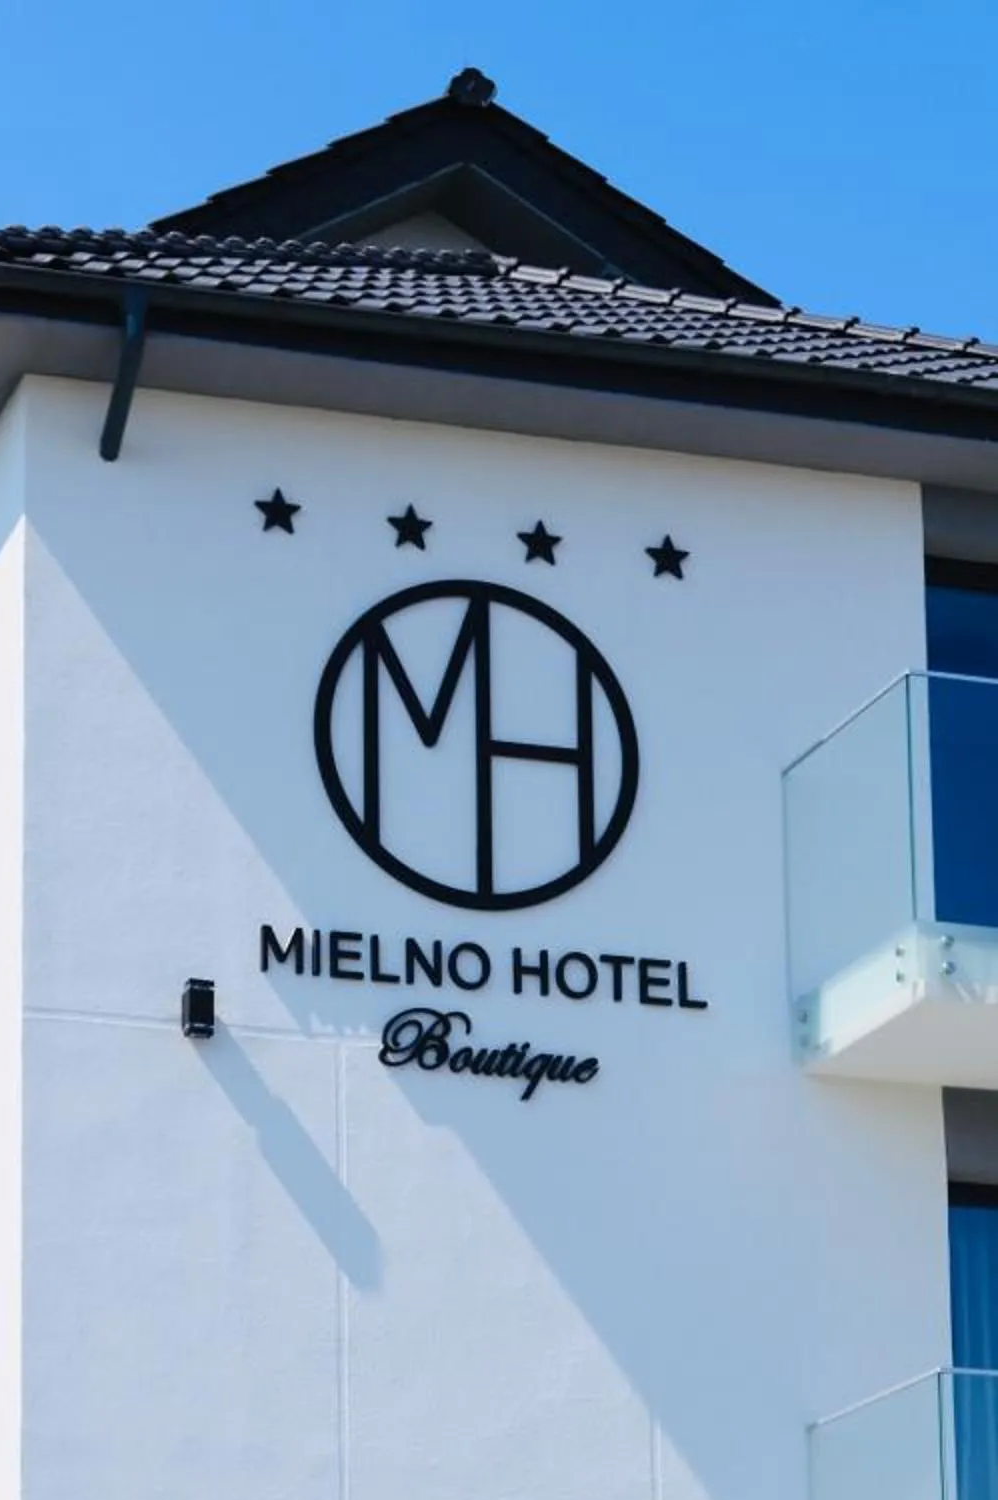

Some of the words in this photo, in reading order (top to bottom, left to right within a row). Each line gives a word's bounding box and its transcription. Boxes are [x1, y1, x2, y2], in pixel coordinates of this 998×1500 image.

[347, 584, 606, 906] MH
[259, 924, 492, 991] MIELNO
[511, 946, 709, 1010] HOTEL
[377, 1006, 600, 1102] Boutique
